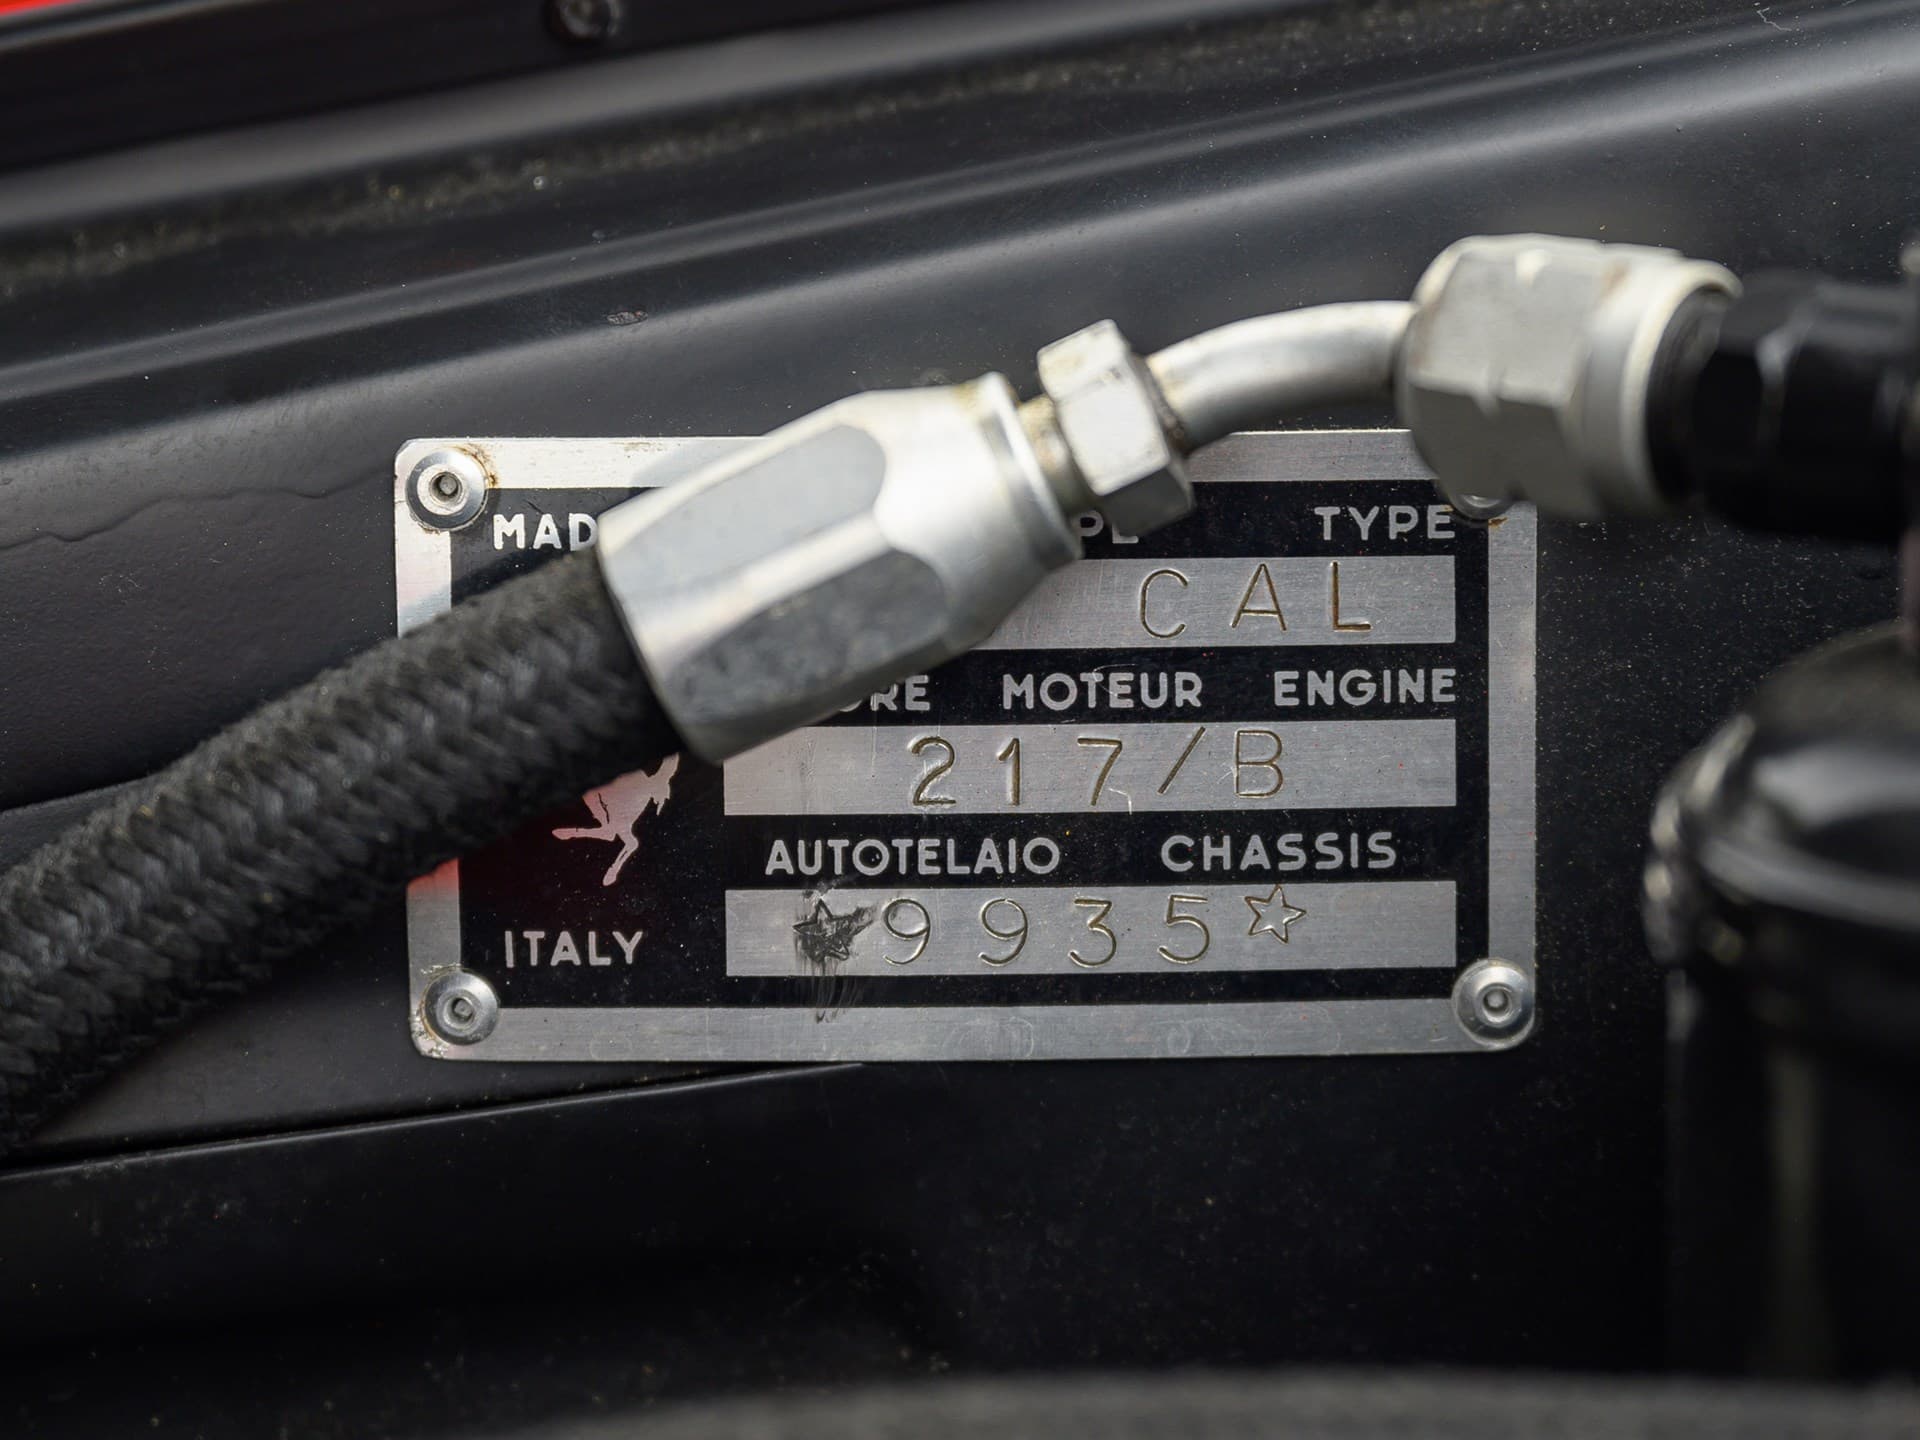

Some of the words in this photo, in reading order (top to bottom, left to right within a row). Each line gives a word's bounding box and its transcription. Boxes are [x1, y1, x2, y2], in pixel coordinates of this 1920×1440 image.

[493, 512, 597, 551] MAD
[1315, 506, 1454, 541] TYPE
[1139, 561, 1372, 639] CAL
[834, 675, 931, 712] RE
[1004, 671, 1203, 711] MOTEUR
[1274, 668, 1456, 707] ENGINE
[907, 726, 1284, 808] 217/B
[765, 836, 1060, 876] AUTOTELAIO
[1161, 831, 1396, 872] CHASSIS
[505, 930, 643, 968] ITALY
